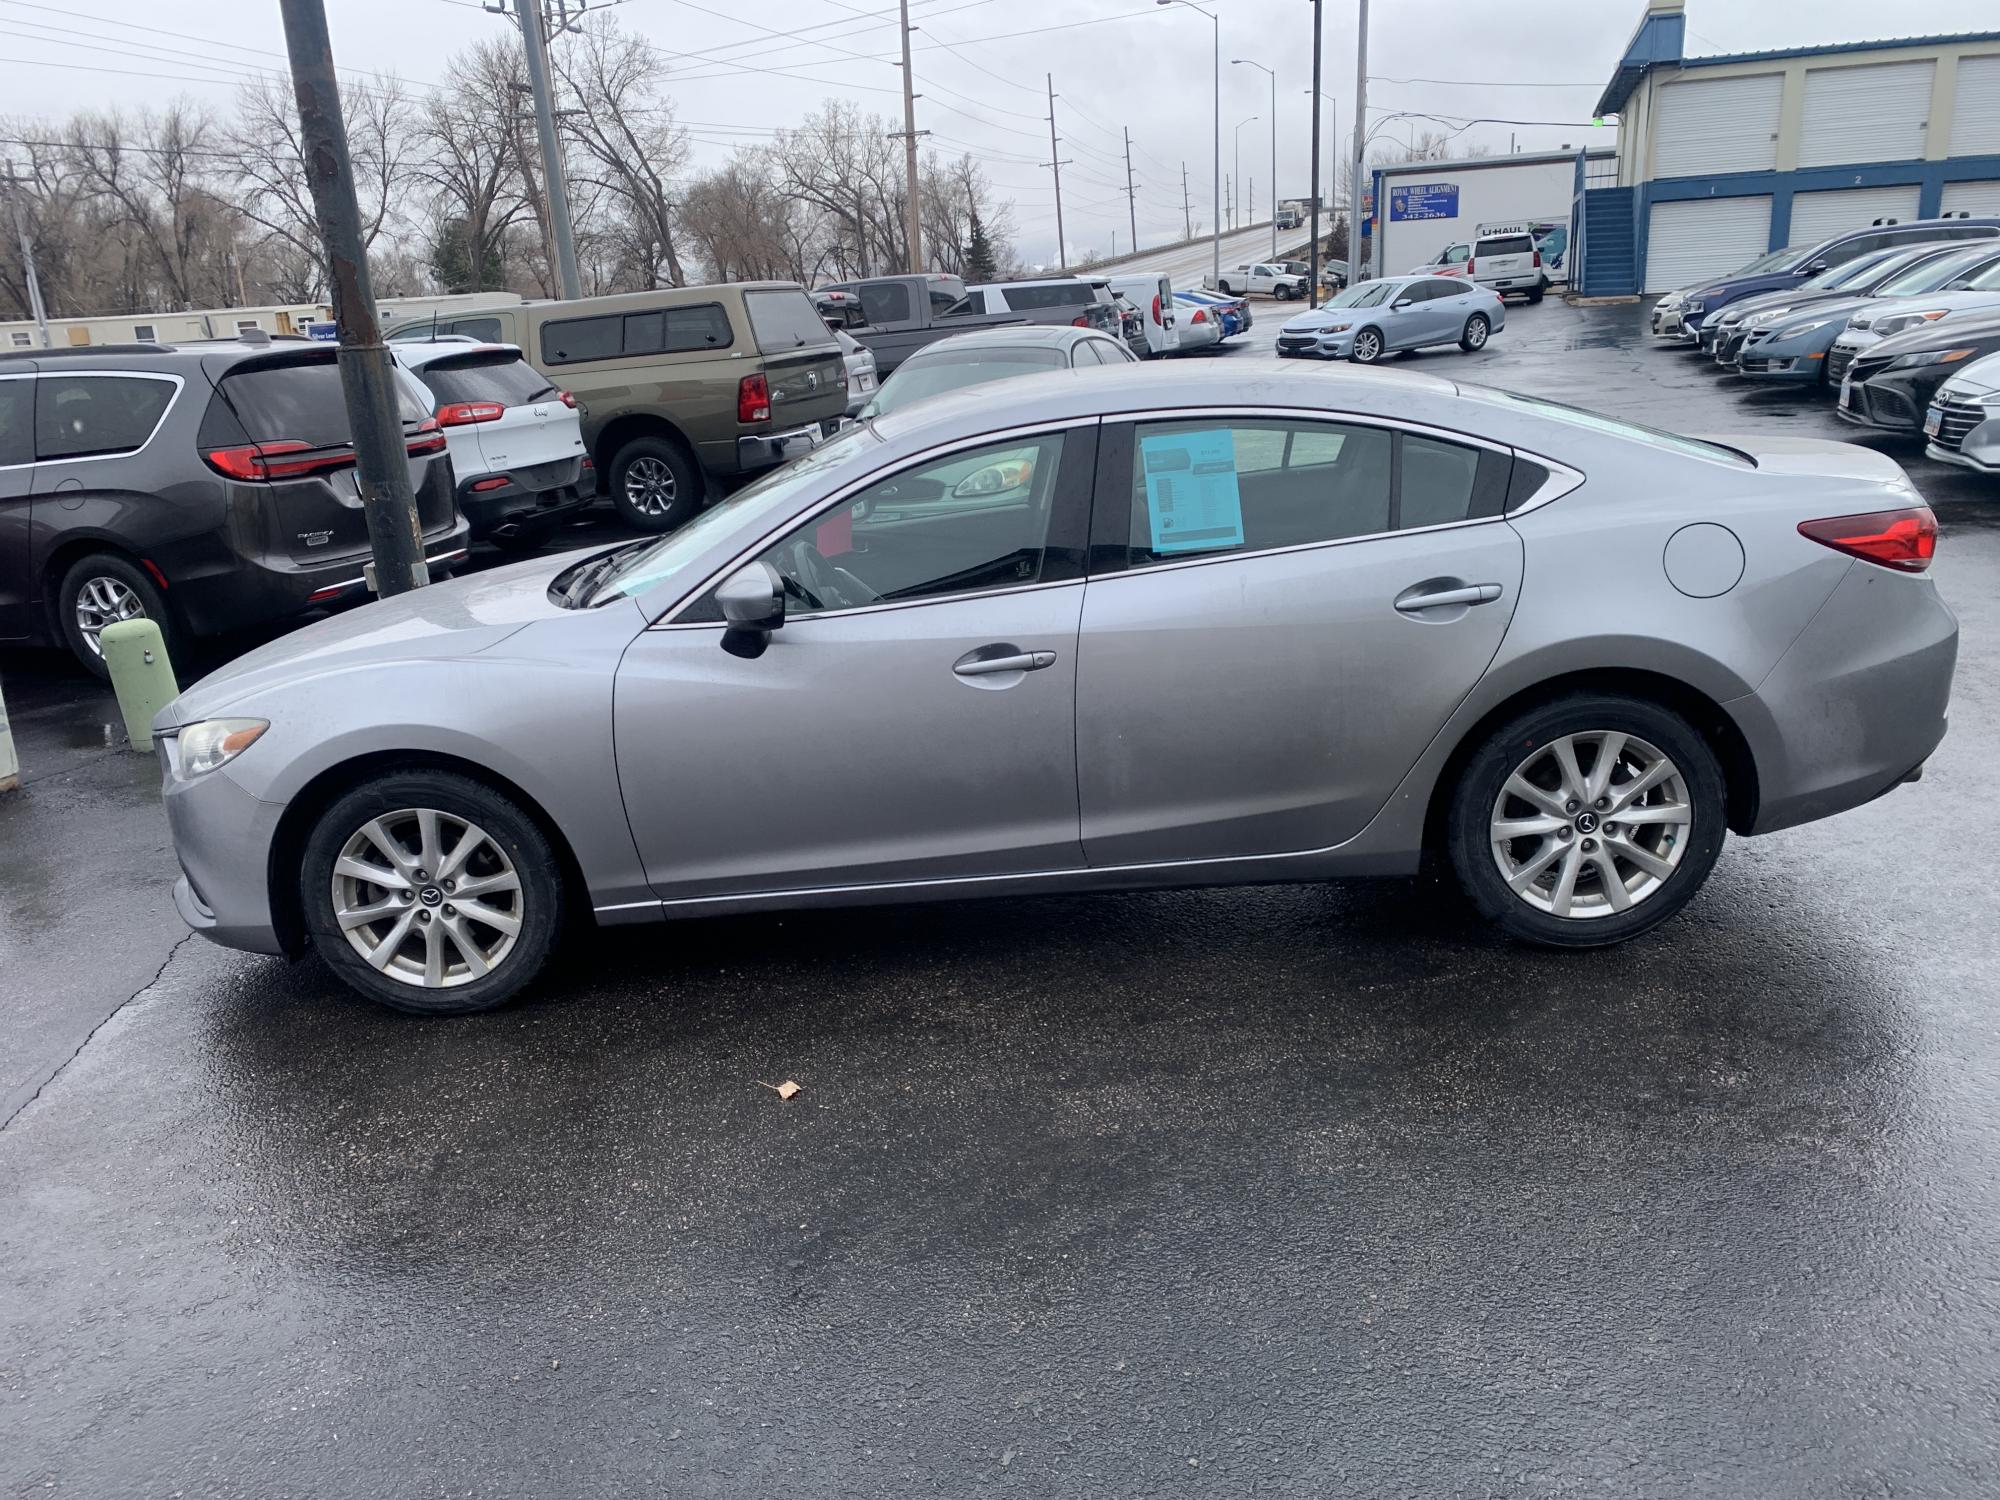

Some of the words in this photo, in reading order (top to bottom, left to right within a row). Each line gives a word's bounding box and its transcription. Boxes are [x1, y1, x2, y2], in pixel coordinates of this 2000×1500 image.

[1855, 176, 1862, 184] 2
[1392, 187, 1409, 197] ROYAL
[1410, 186, 1428, 195] WHEEL
[1429, 184, 1457, 194] ALIGNMENT
